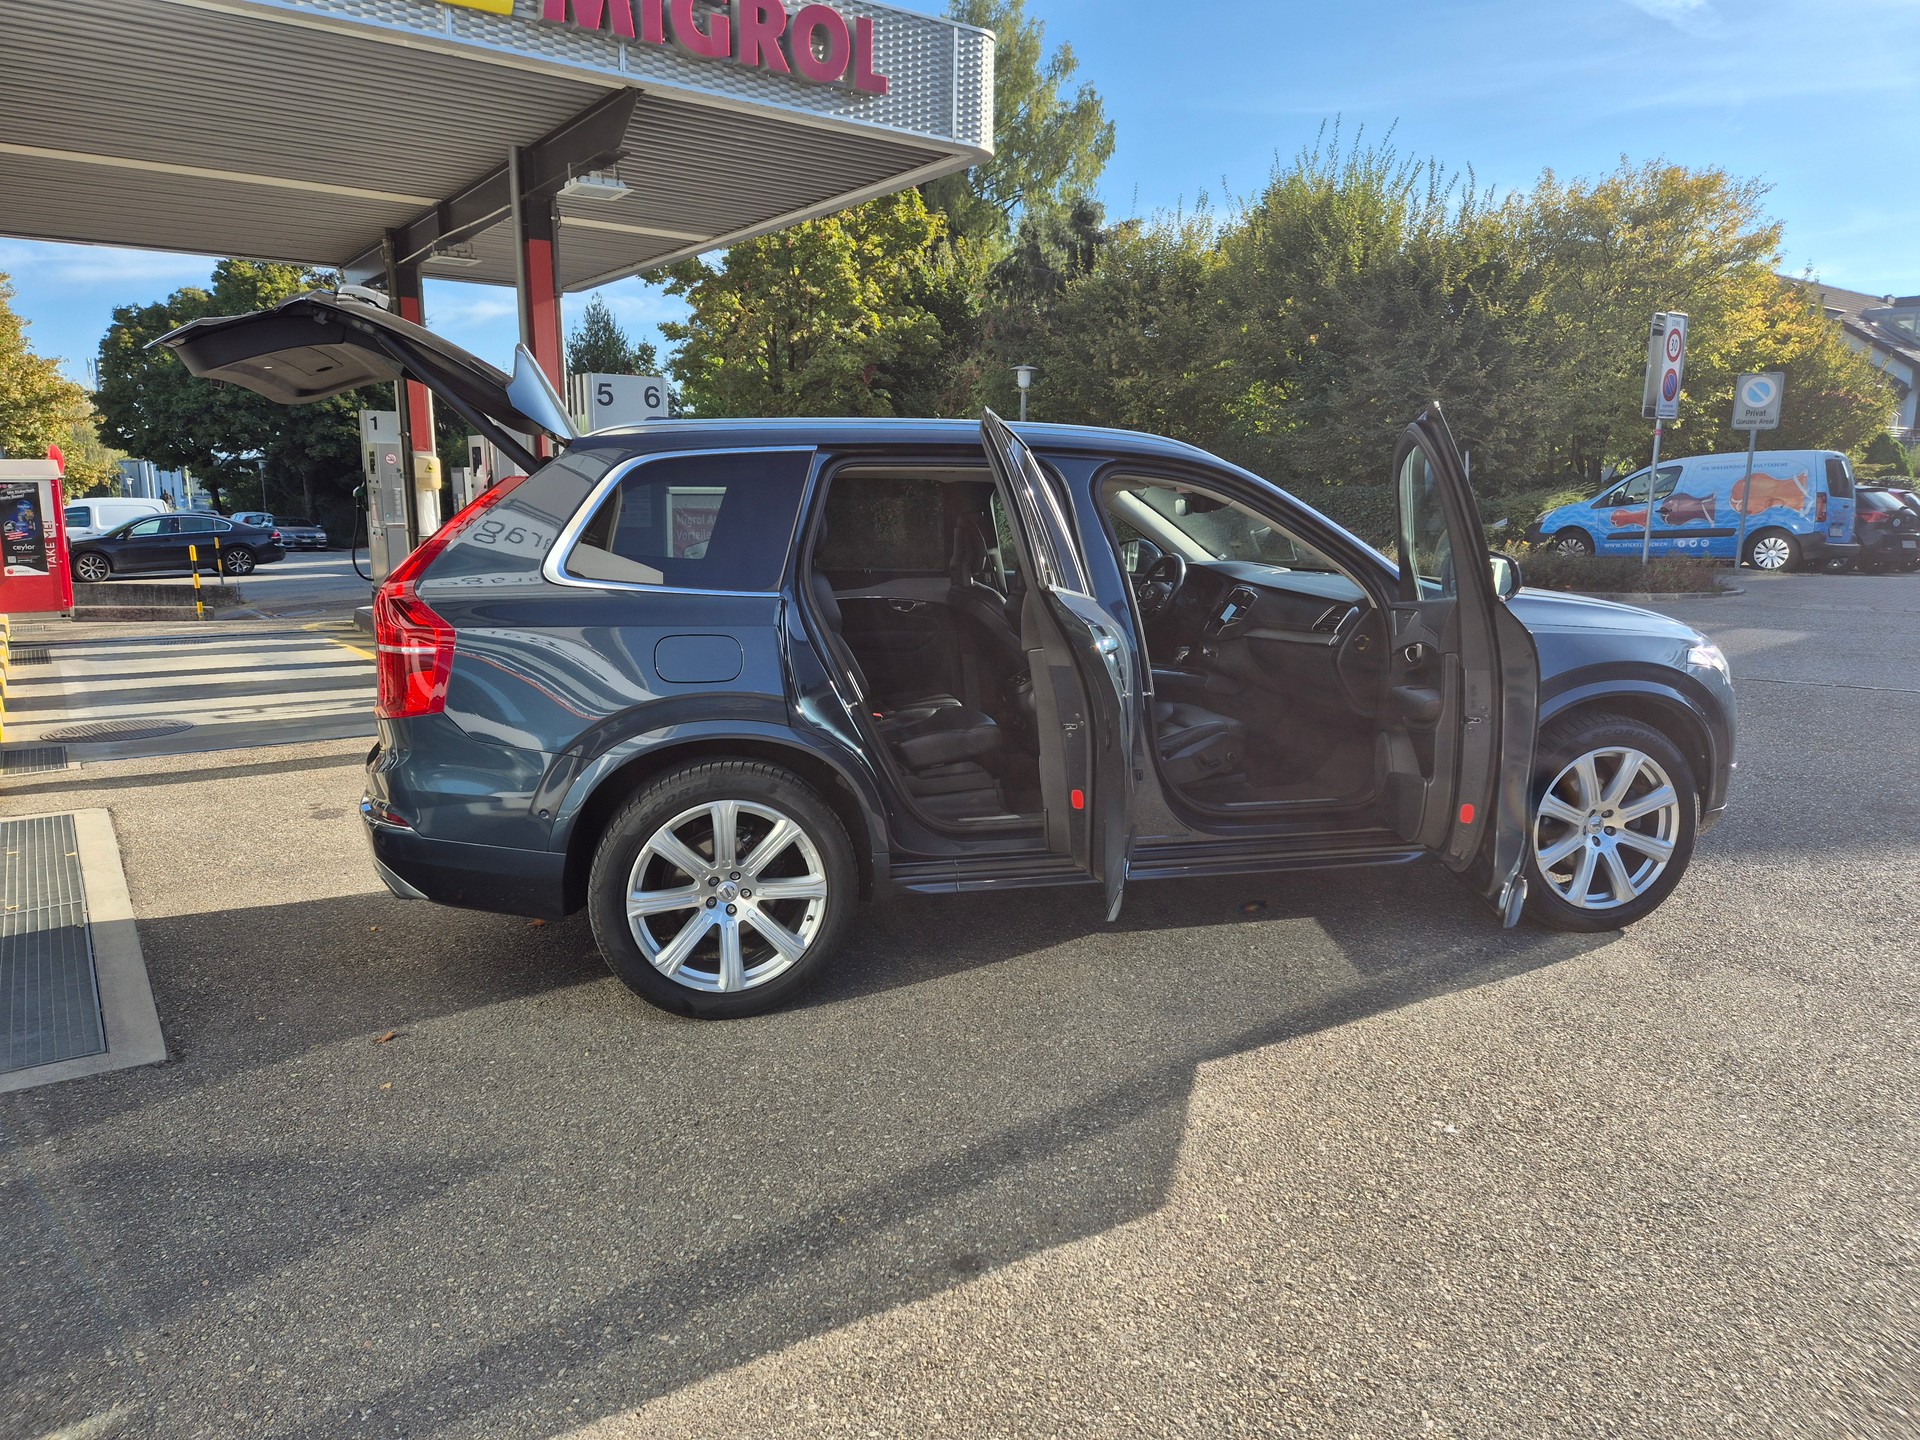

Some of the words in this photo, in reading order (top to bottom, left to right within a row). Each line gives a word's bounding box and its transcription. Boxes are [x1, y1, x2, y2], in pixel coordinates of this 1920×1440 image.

[1670, 338, 1679, 352] 30
[596, 382, 614, 407] 5
[643, 385, 661, 409] 6
[1745, 409, 1767, 417] Privat
[369, 416, 378, 431] 1
[676, 513, 705, 528] Migrol
[707, 513, 718, 525] A
[677, 528, 712, 540] Vorteile
[12, 543, 36, 551] ceylor
[45, 542, 57, 569] TAKE
